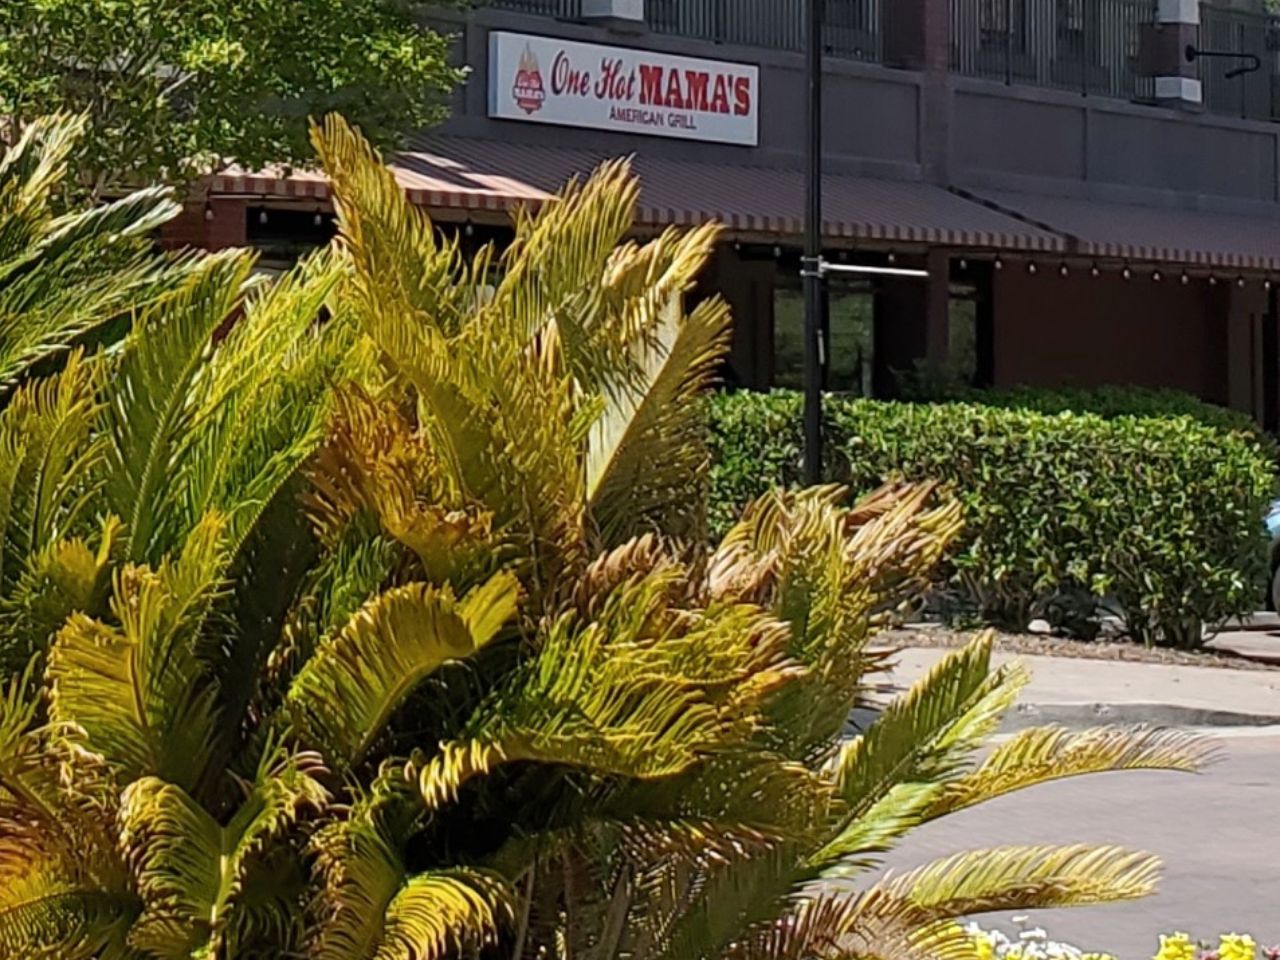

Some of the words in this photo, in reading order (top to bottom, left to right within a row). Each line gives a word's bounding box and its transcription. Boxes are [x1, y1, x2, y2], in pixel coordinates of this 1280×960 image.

[551, 50, 589, 96] One
[594, 56, 636, 101] Hot
[639, 64, 750, 117] MAMA'S
[609, 105, 664, 128] AMERICAN
[668, 113, 697, 130] GRILL
